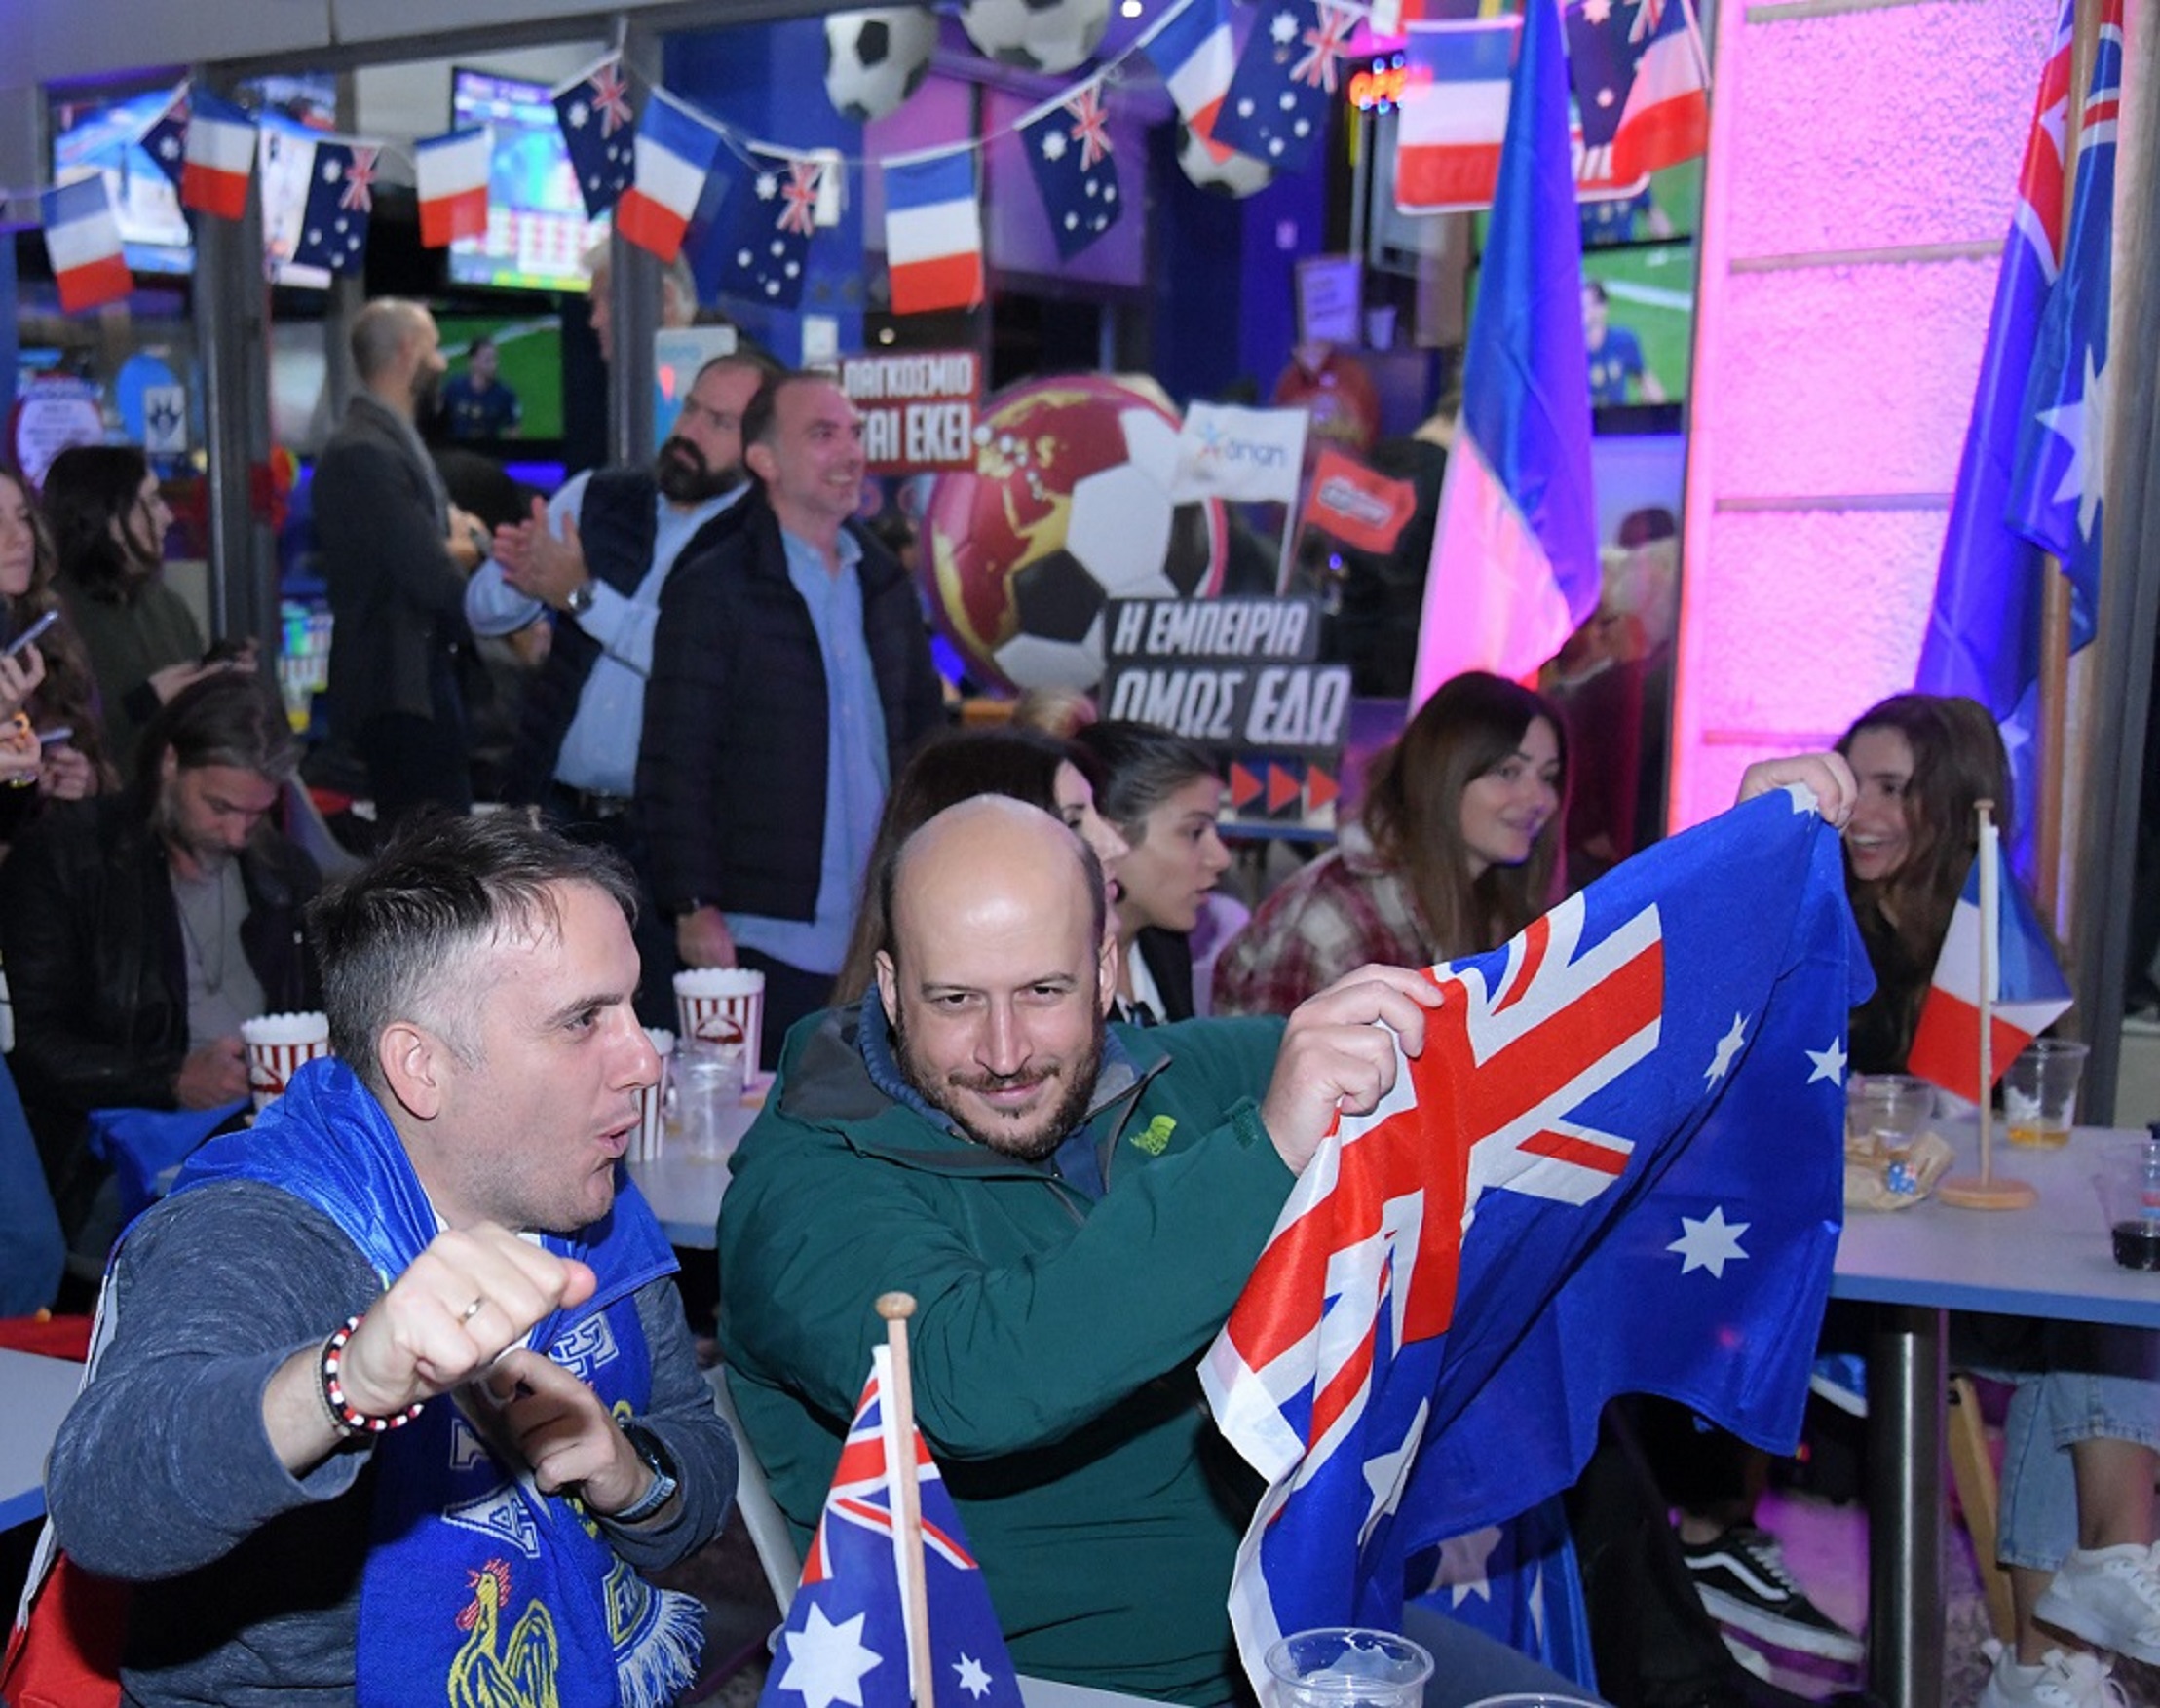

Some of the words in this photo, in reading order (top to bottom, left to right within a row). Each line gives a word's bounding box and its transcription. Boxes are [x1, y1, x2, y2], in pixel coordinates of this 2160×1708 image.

[906, 403, 972, 463] ΕΚΕΙ
[1112, 601, 1147, 655] Η
[1146, 601, 1309, 656] ΕΜΠΕΙΡΙΑ
[1245, 664, 1352, 745] ΕΔΩ
